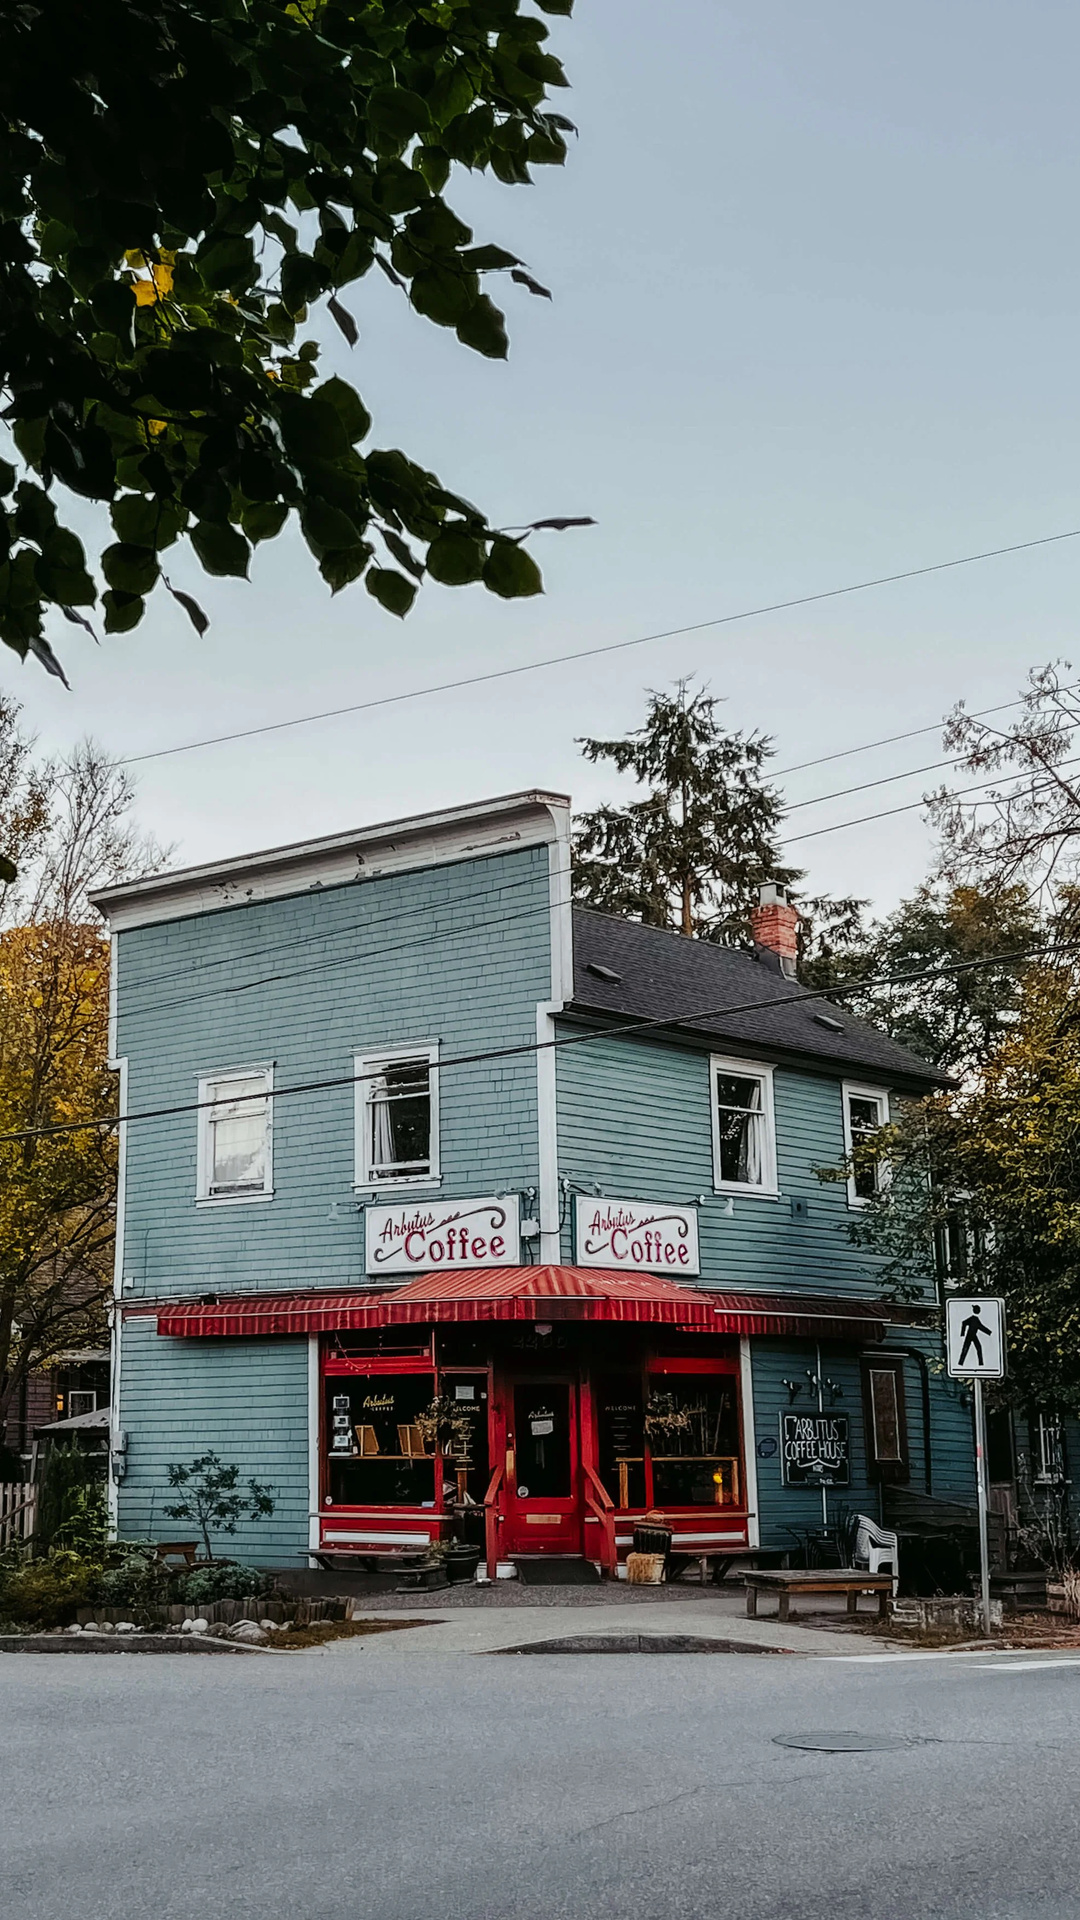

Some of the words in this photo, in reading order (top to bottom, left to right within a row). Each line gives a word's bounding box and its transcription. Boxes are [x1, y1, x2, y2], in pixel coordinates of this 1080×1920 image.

[379, 1210, 435, 1243] Arbutus
[588, 1206, 636, 1235] Arbutus
[404, 1227, 506, 1263] Coffee
[611, 1228, 690, 1264] Coffee
[795, 1417, 839, 1440] ARBUTUS
[785, 1440, 818, 1460] COFFEE
[818, 1440, 847, 1460] HOUSE
